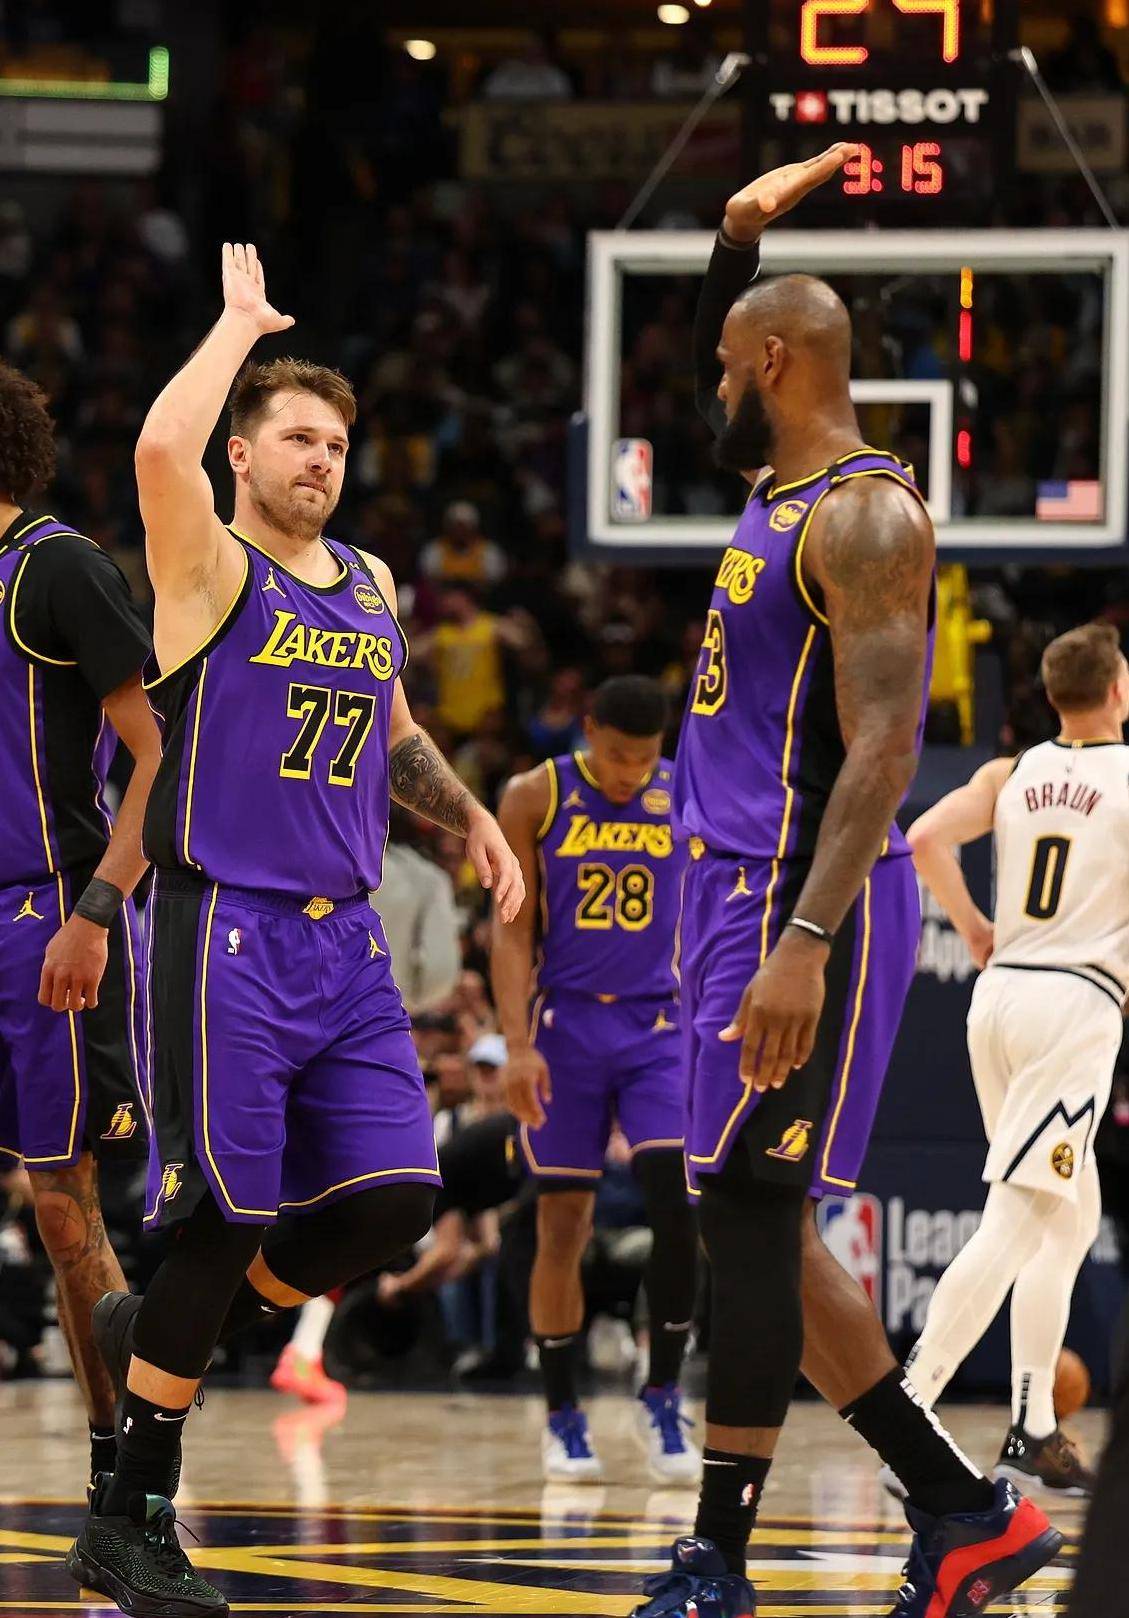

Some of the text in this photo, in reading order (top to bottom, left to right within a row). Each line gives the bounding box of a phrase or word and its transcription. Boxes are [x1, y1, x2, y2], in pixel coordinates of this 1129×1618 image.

[828, 89, 989, 124] TISSOT
[248, 609, 395, 681] LAKERS
[279, 682, 377, 787] 77
[1025, 781, 1103, 817] BRAUN
[555, 814, 674, 859] LAKERS
[575, 862, 655, 932] 28
[1023, 833, 1073, 922] 0
